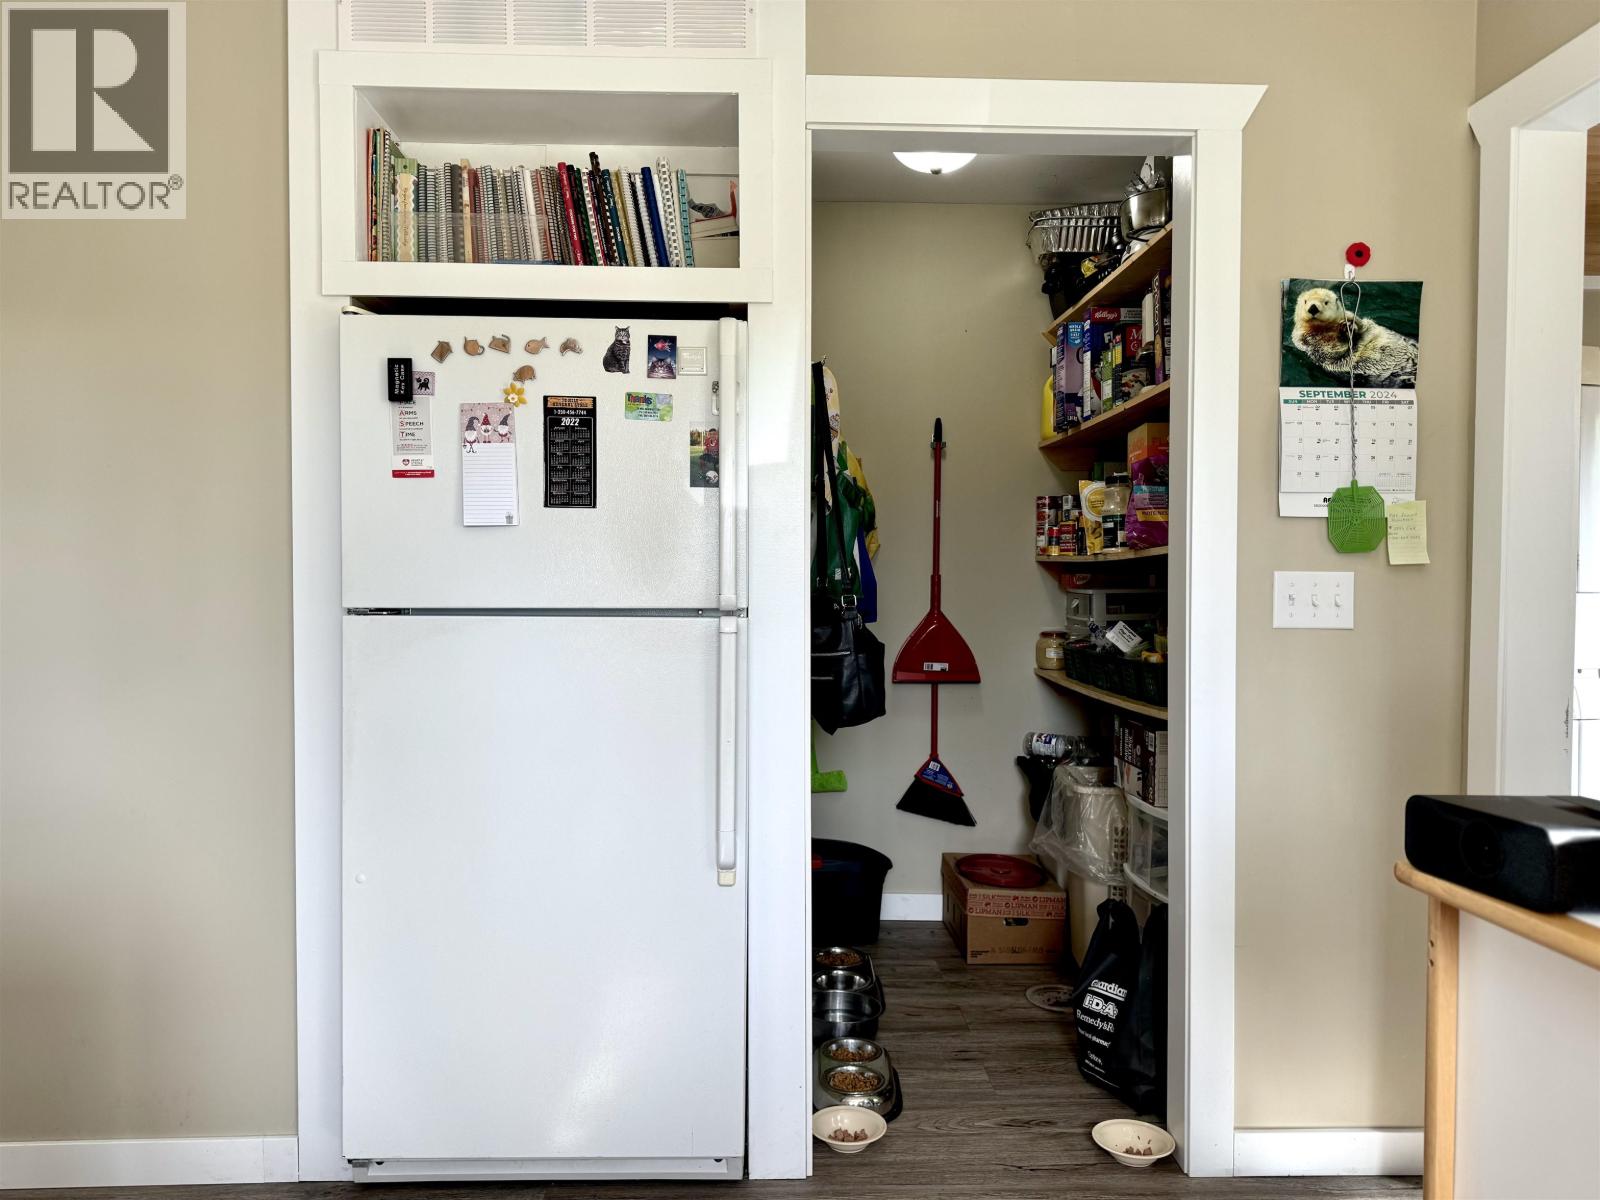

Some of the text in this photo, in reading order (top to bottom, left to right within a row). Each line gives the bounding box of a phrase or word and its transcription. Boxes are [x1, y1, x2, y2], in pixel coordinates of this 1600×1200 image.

[1095, 311, 1118, 319] Kellogg's
[1299, 390, 1397, 399] SEPTEMBER 2024
[560, 417, 580, 426] 2022
[1076, 1009, 1115, 1033] Remedy'sR
